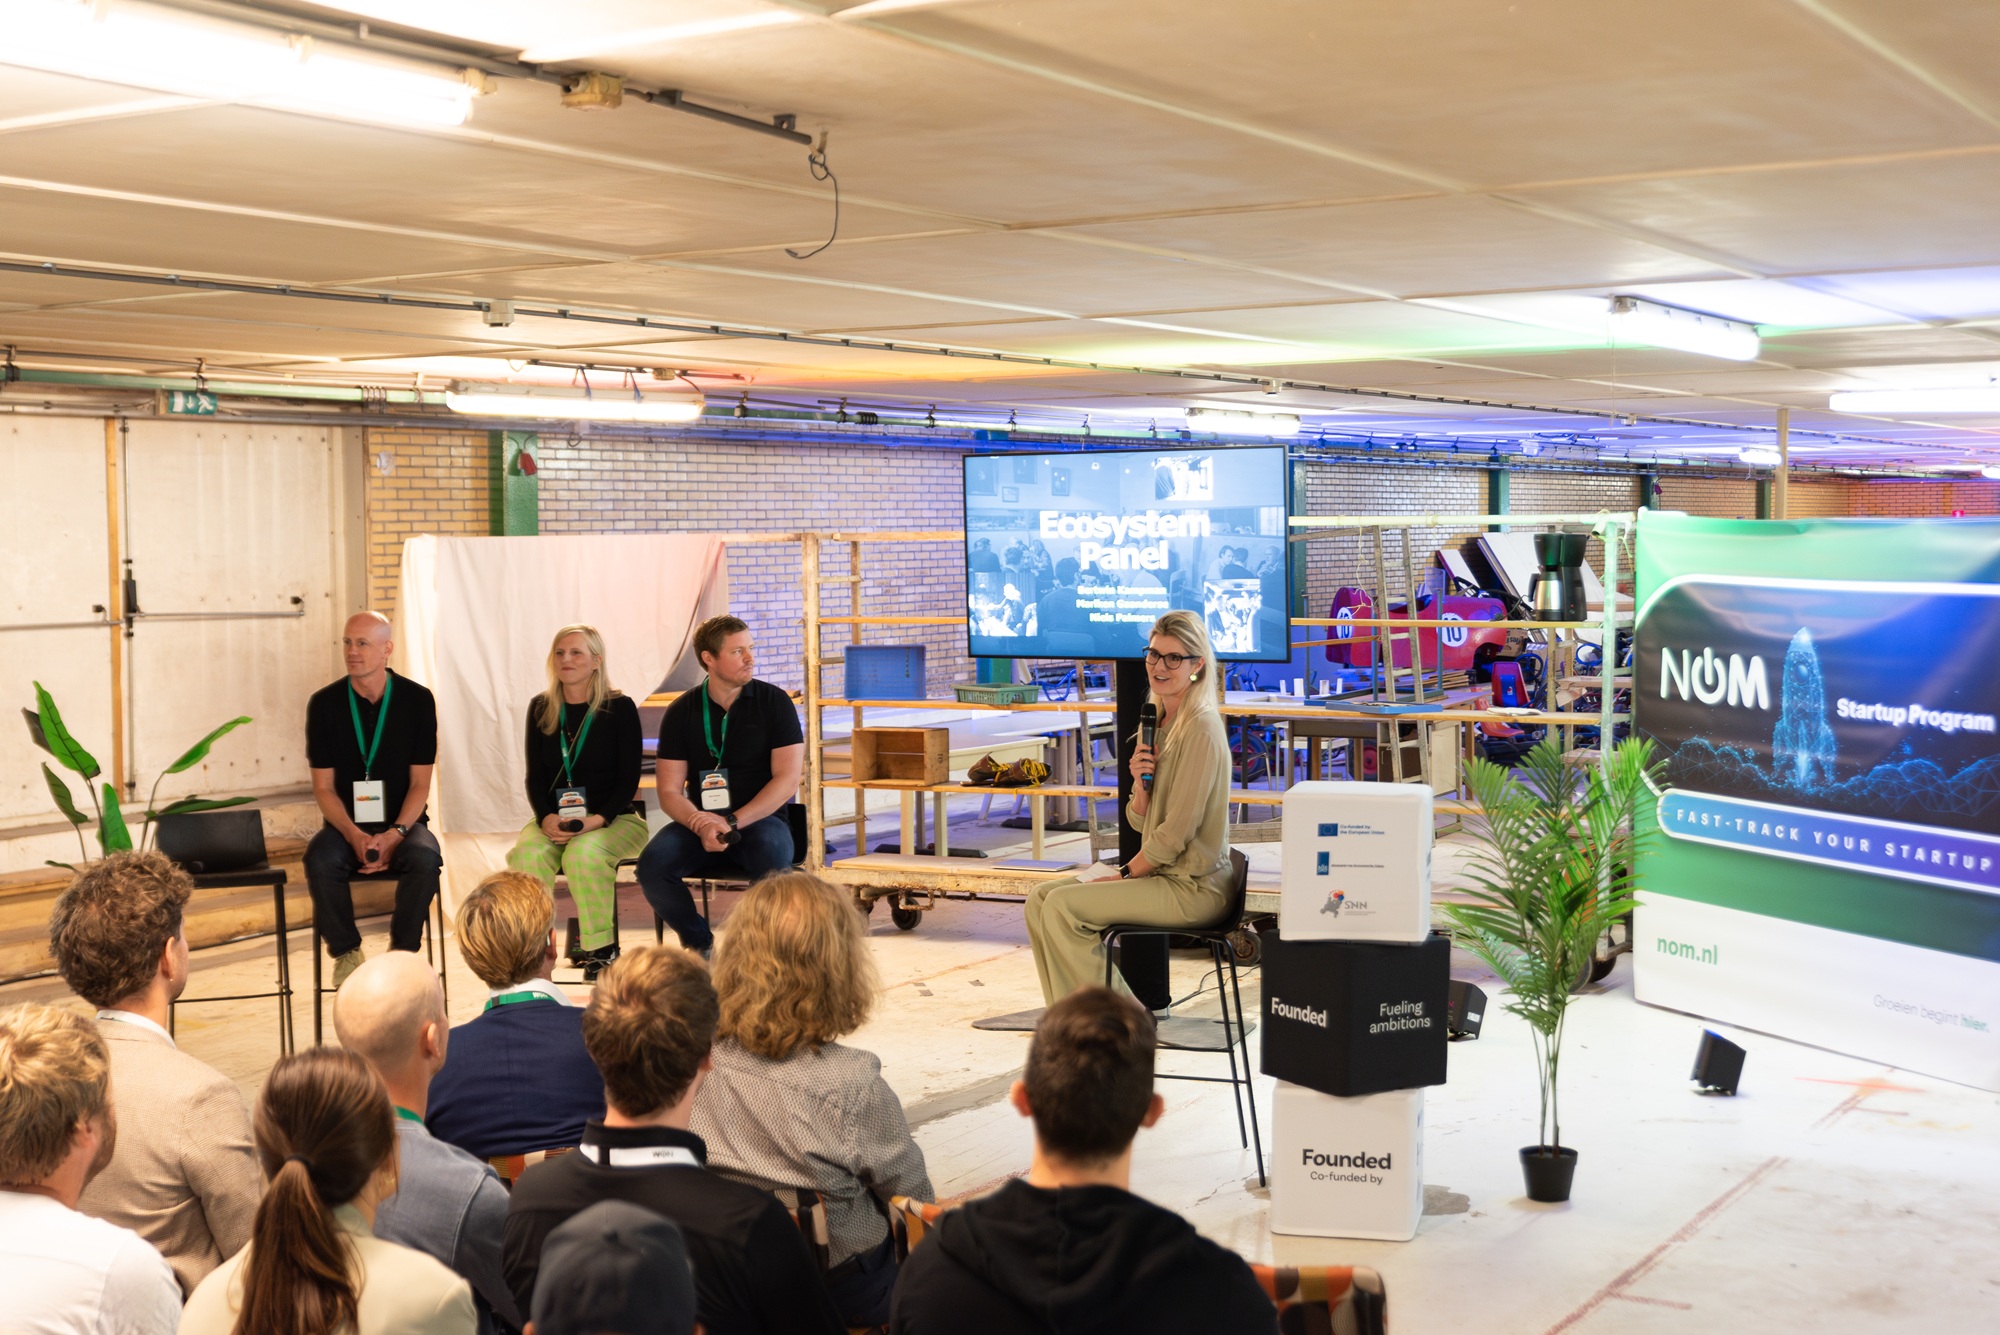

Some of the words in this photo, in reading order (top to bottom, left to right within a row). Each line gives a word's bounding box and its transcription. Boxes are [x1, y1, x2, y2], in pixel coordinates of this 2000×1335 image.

[1039, 509, 1211, 545] Ecosystem
[1080, 540, 1169, 570] Panel
[1444, 617, 1462, 642] 10
[1660, 647, 1769, 710] NOM
[1836, 698, 1907, 726] Startup
[1908, 704, 1995, 732] Program
[1676, 809, 1799, 841] FAST-TRACK
[1813, 831, 1869, 852] YOUR
[1885, 843, 1992, 872] STARTUP
[1344, 900, 1368, 909] SNN
[1657, 938, 1718, 965] nom.nl
[1271, 997, 1327, 1028] Founded
[1379, 1000, 1423, 1016] Fueling
[1873, 994, 1918, 1016] Groeien
[1920, 1003, 1959, 1025] begint
[1369, 1017, 1431, 1034] ambitions
[1302, 1148, 1391, 1170] Founded
[1310, 1171, 1367, 1182] Co-funded
[1370, 1174, 1383, 1185] by
